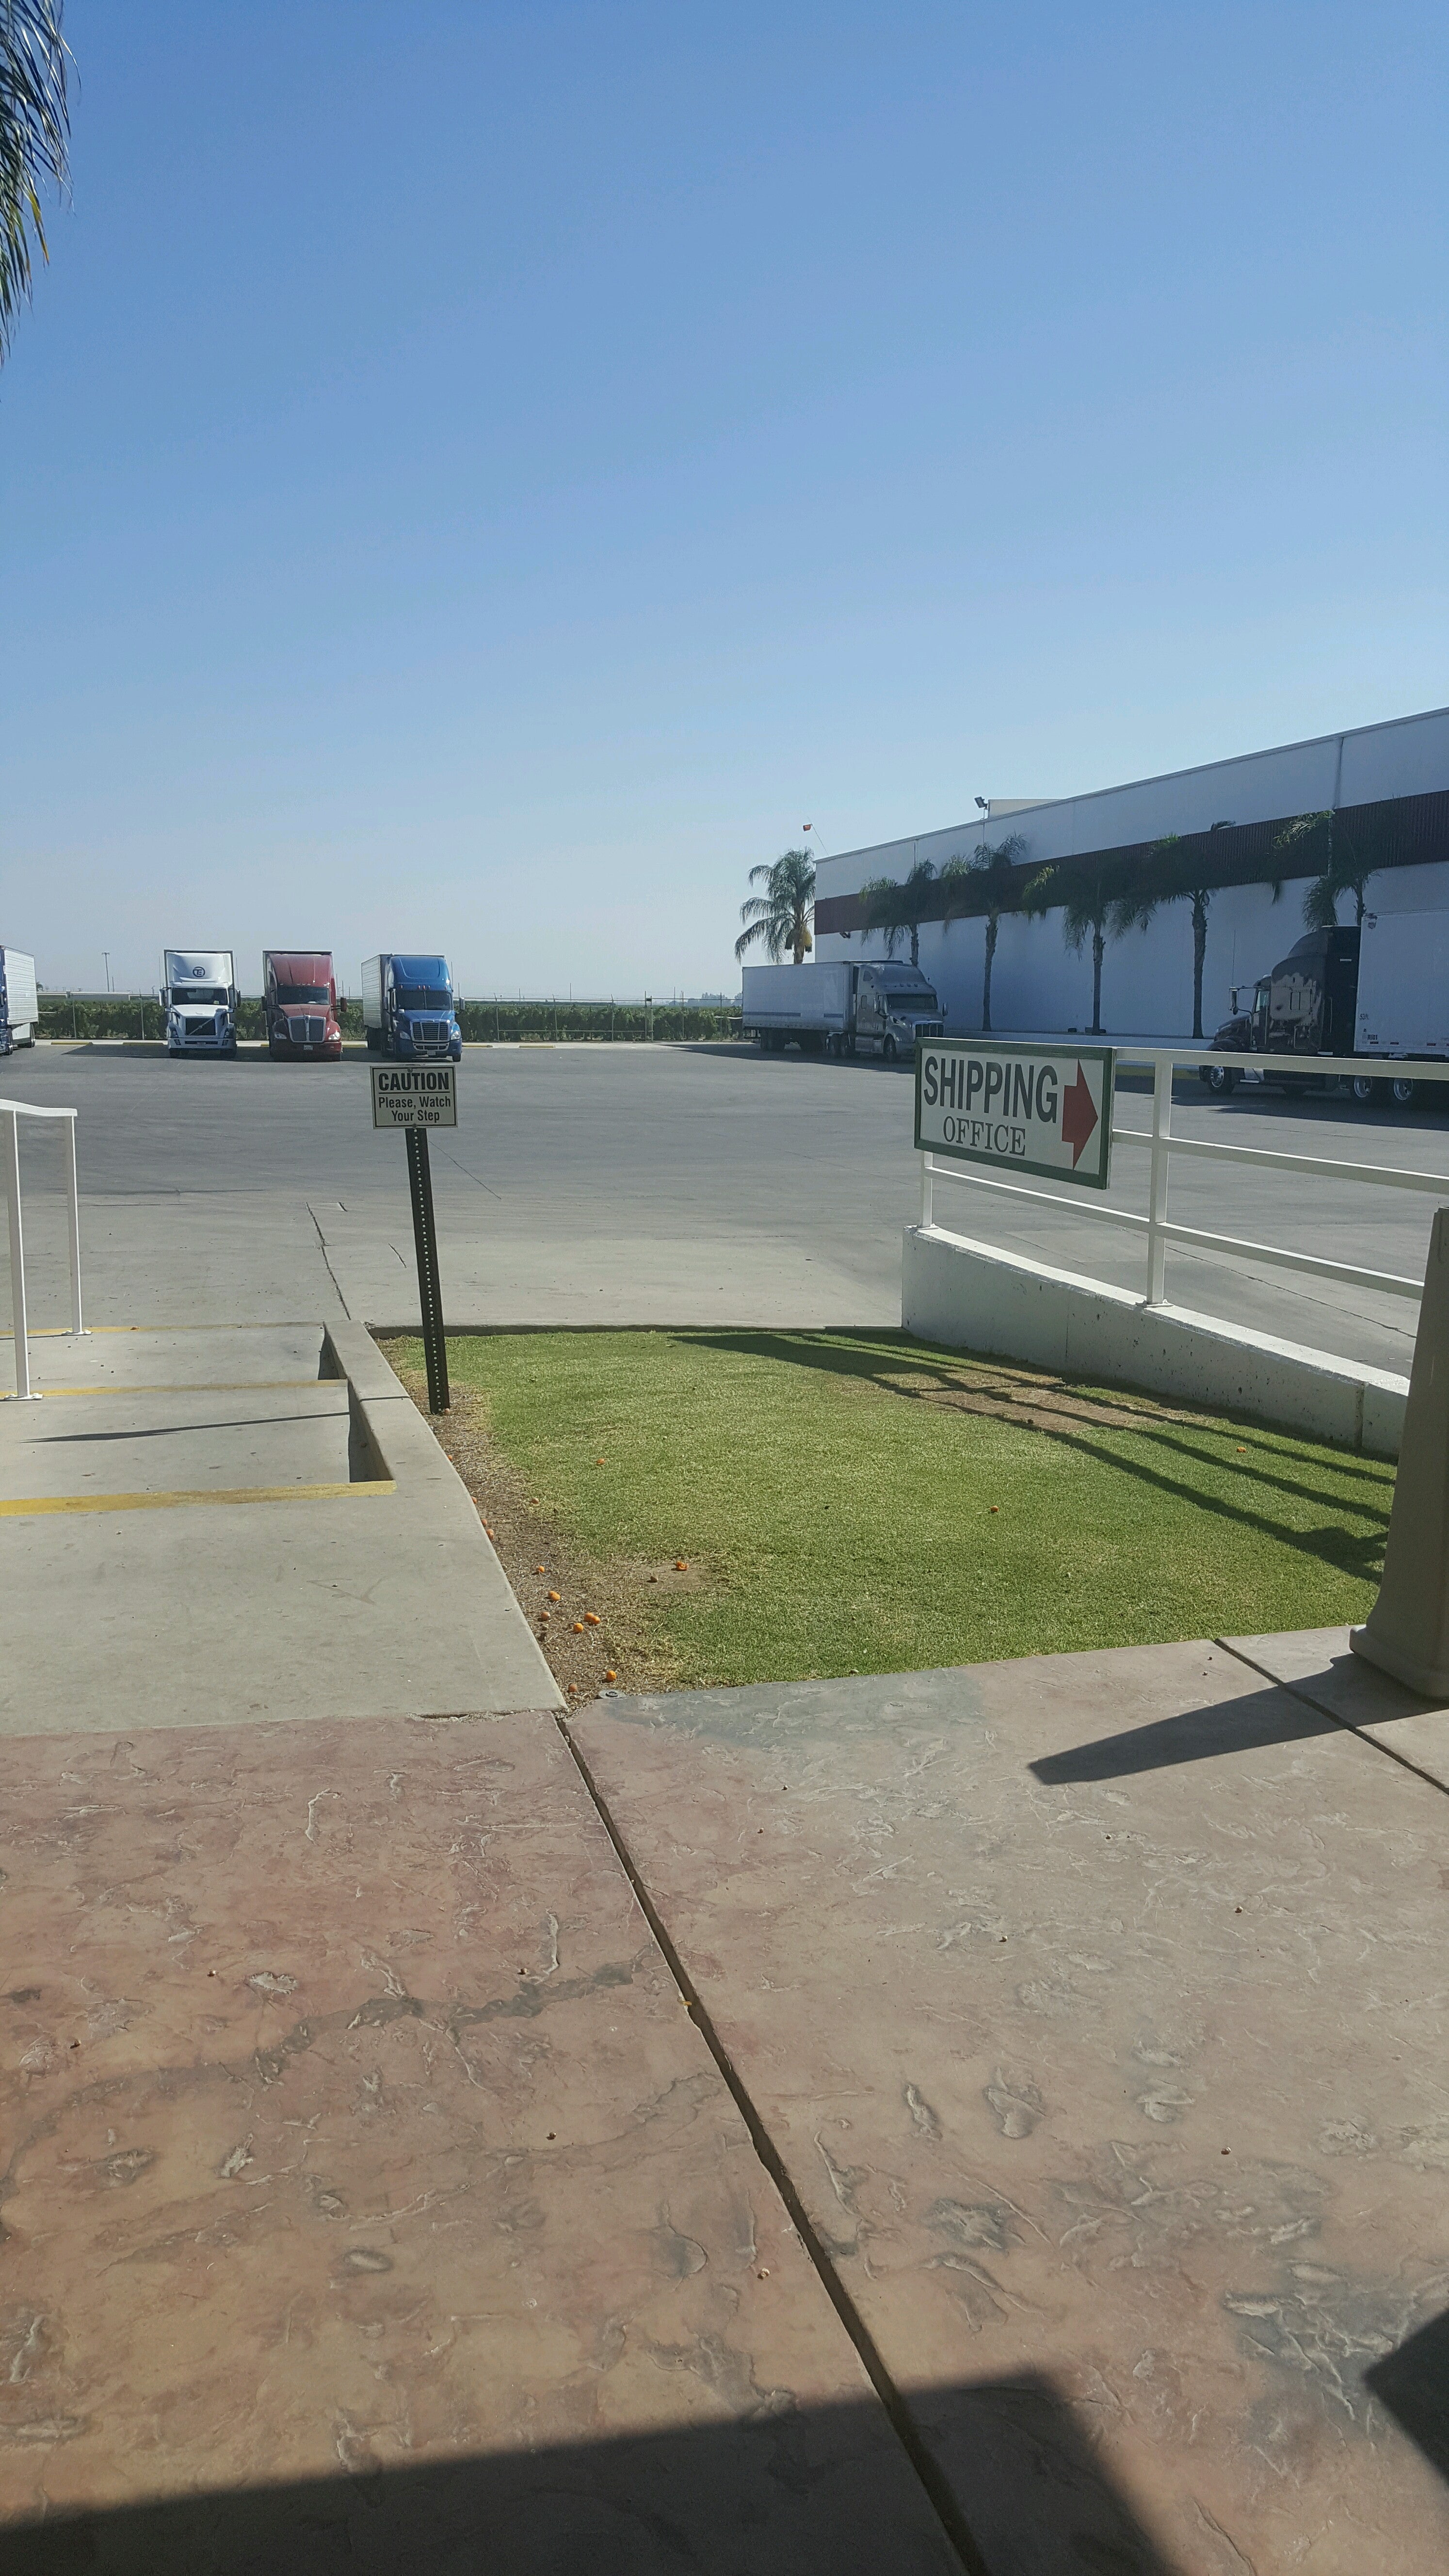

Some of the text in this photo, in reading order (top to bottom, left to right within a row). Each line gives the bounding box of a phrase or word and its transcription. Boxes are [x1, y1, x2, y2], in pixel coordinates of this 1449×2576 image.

[379, 1072, 449, 1091] CAUTION
[924, 1056, 1058, 1123] SHIPPING
[379, 1096, 451, 1109] Please, Watch
[391, 1110, 440, 1123] Your Step
[943, 1116, 1026, 1156] OFFICE
